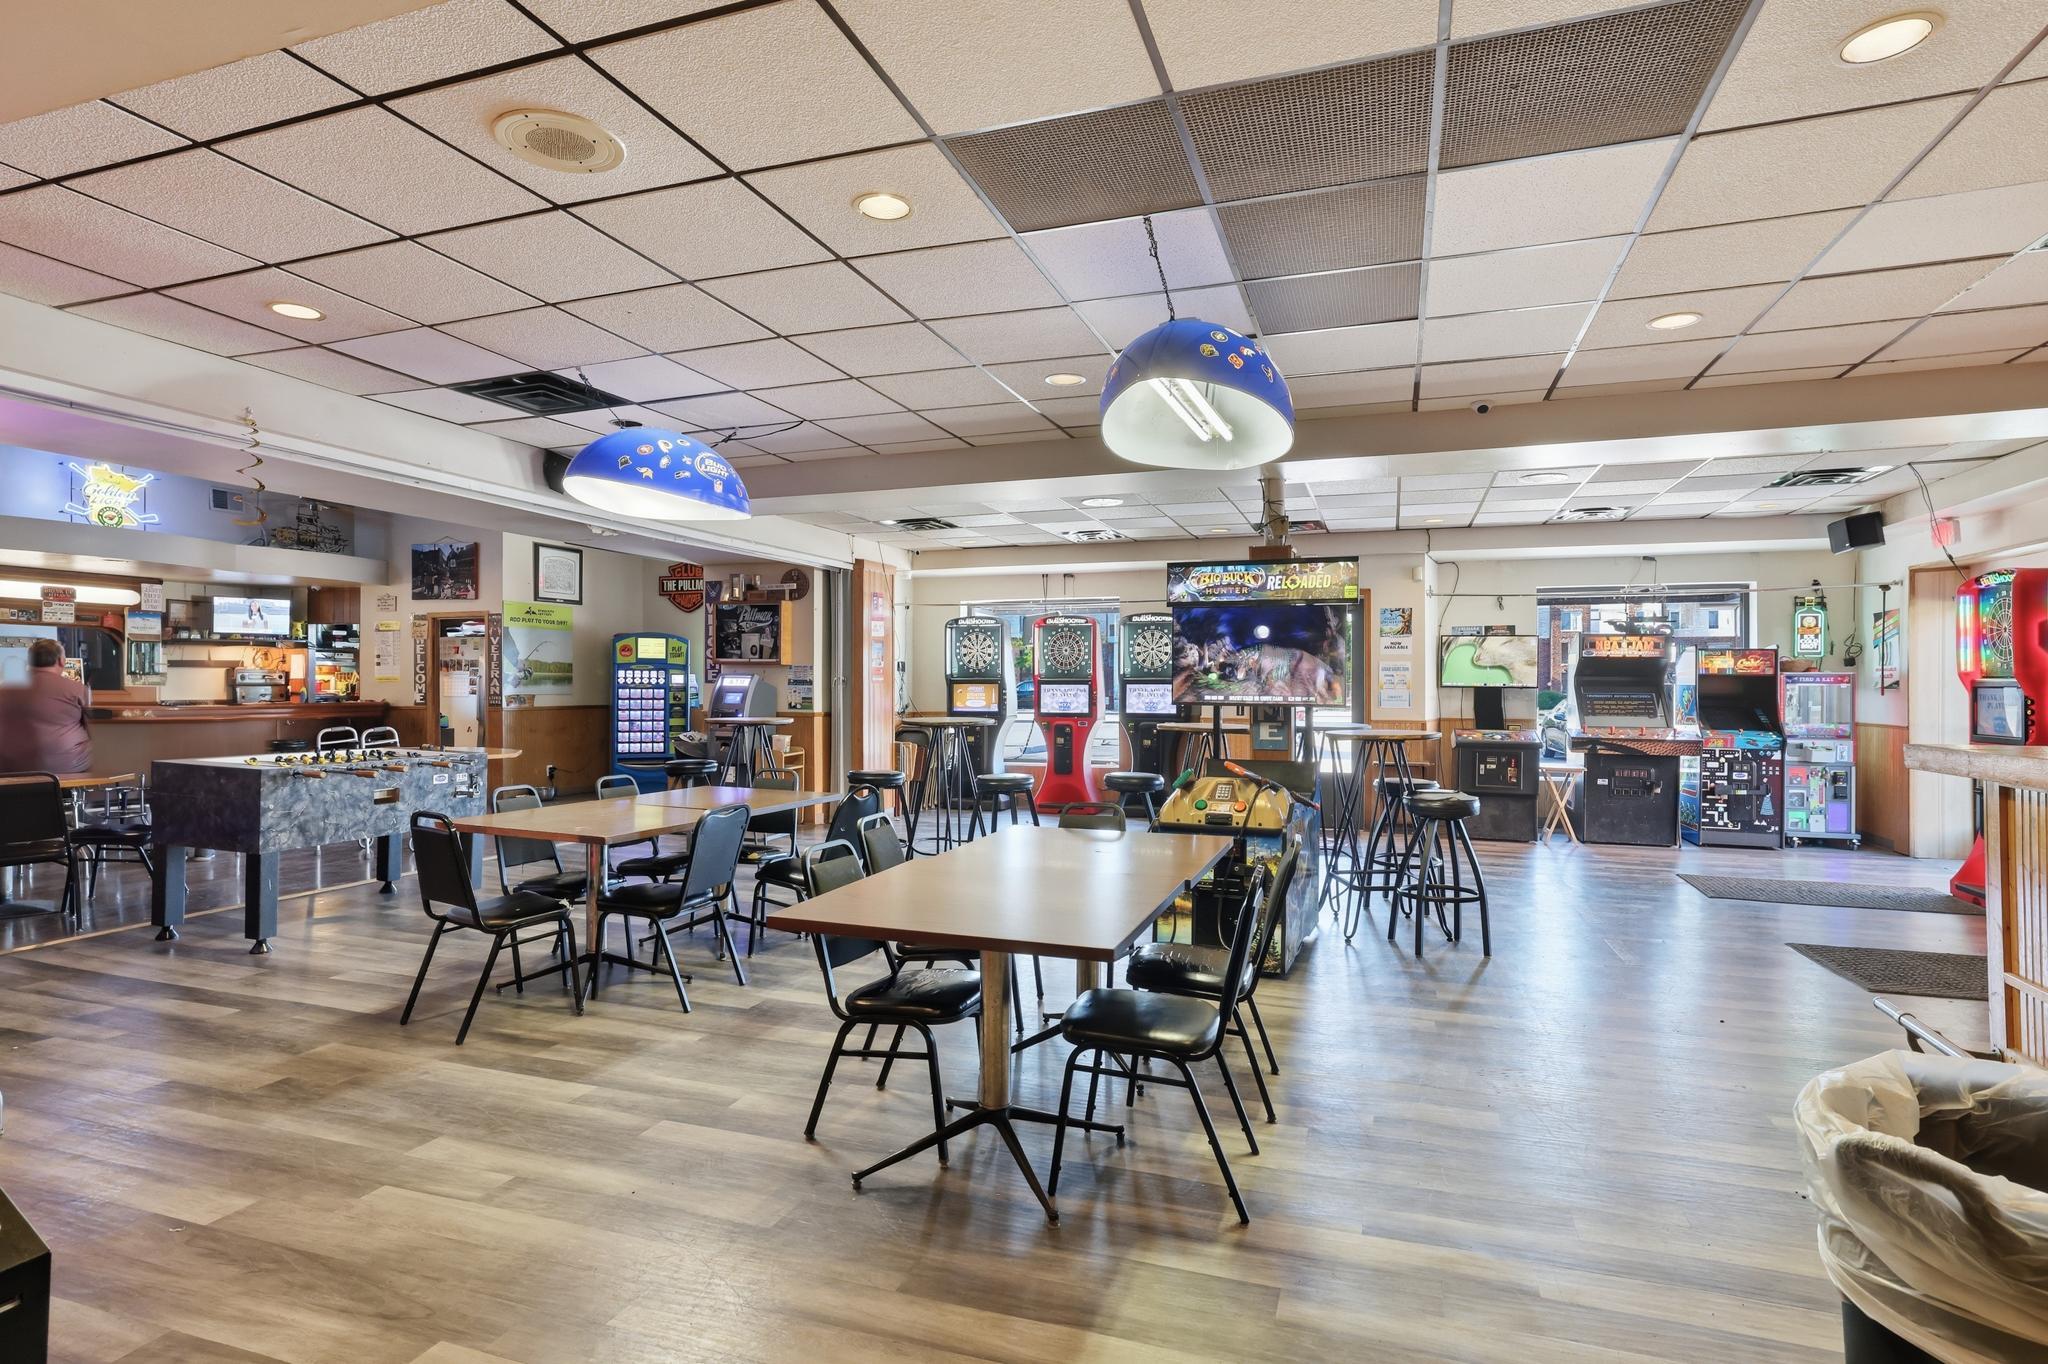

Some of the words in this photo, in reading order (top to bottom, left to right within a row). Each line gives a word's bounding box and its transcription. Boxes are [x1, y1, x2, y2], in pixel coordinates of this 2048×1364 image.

[701, 465, 729, 477] LIGHT
[704, 459, 727, 471] BUD
[664, 580, 678, 592] THE
[1201, 573, 1221, 586] BIG
[1223, 571, 1253, 584] BUCK
[1267, 574, 1331, 590] RELOADED
[1595, 640, 1618, 650] NBA
[1631, 640, 1655, 650] JAM
[490, 637, 500, 695] VETERAN
